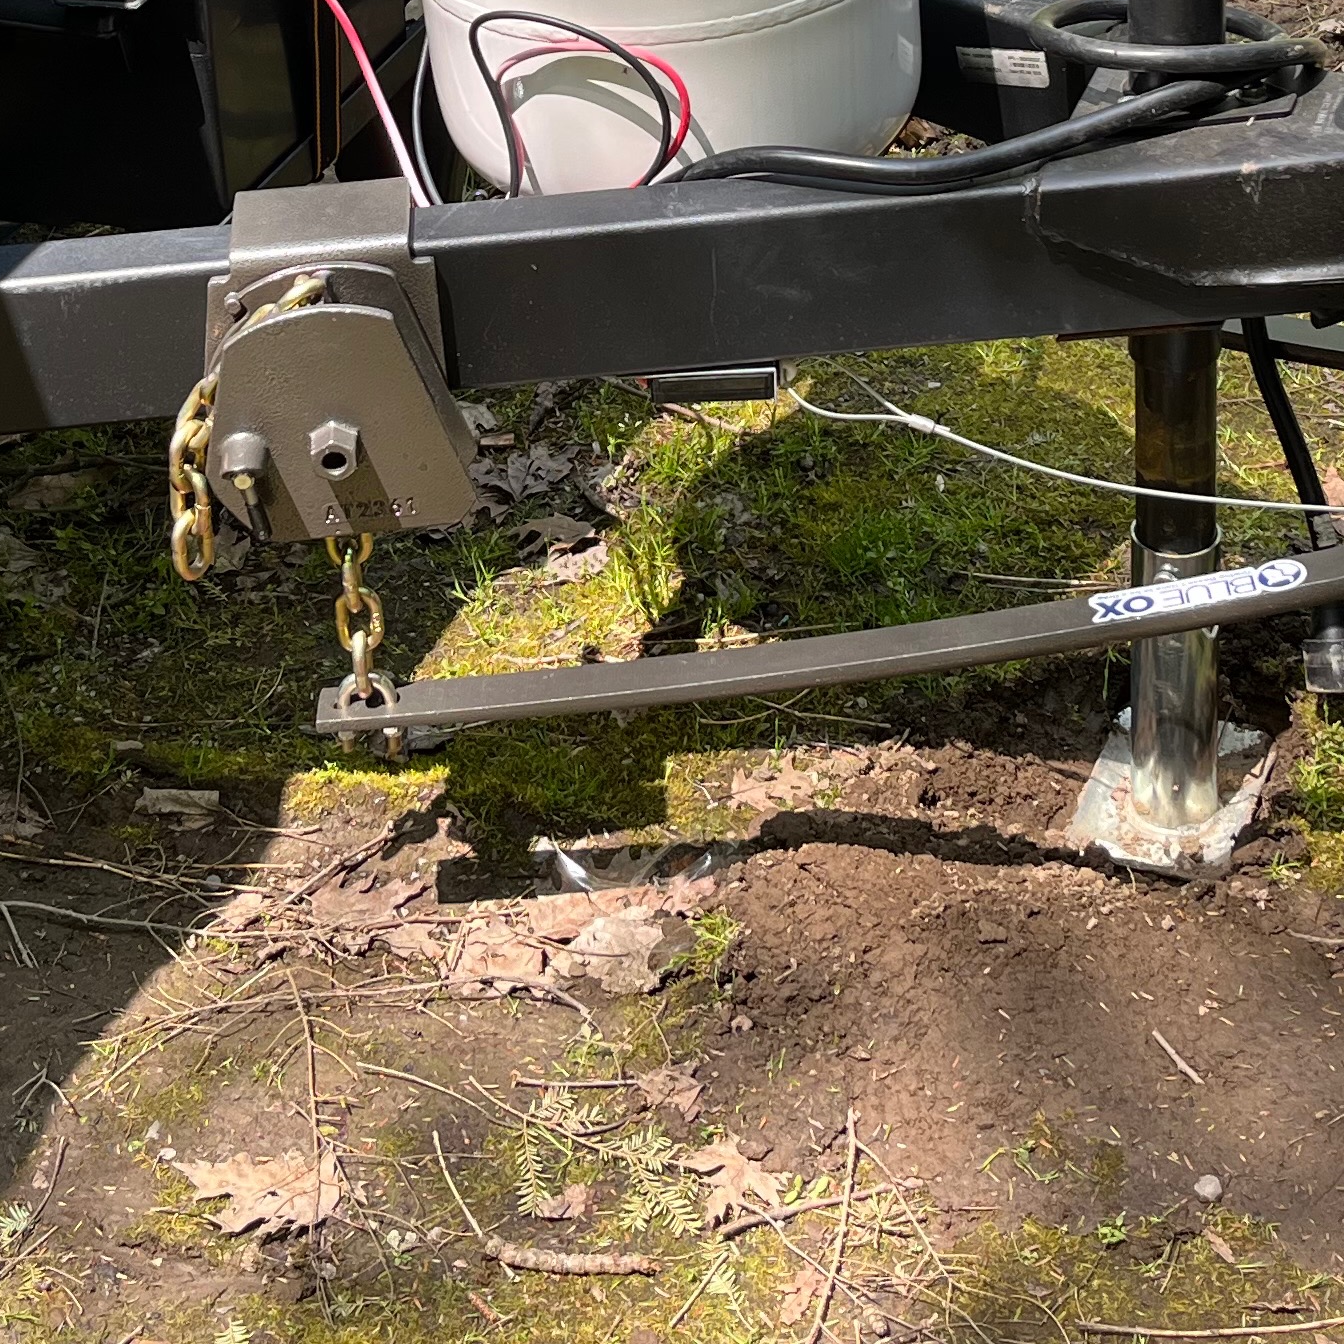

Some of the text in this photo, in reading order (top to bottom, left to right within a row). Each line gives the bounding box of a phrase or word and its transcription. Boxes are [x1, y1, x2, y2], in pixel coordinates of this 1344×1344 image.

[325, 497, 417, 524] AT2361
[1162, 575, 1257, 609] BLUE
[1096, 595, 1155, 620] OX
